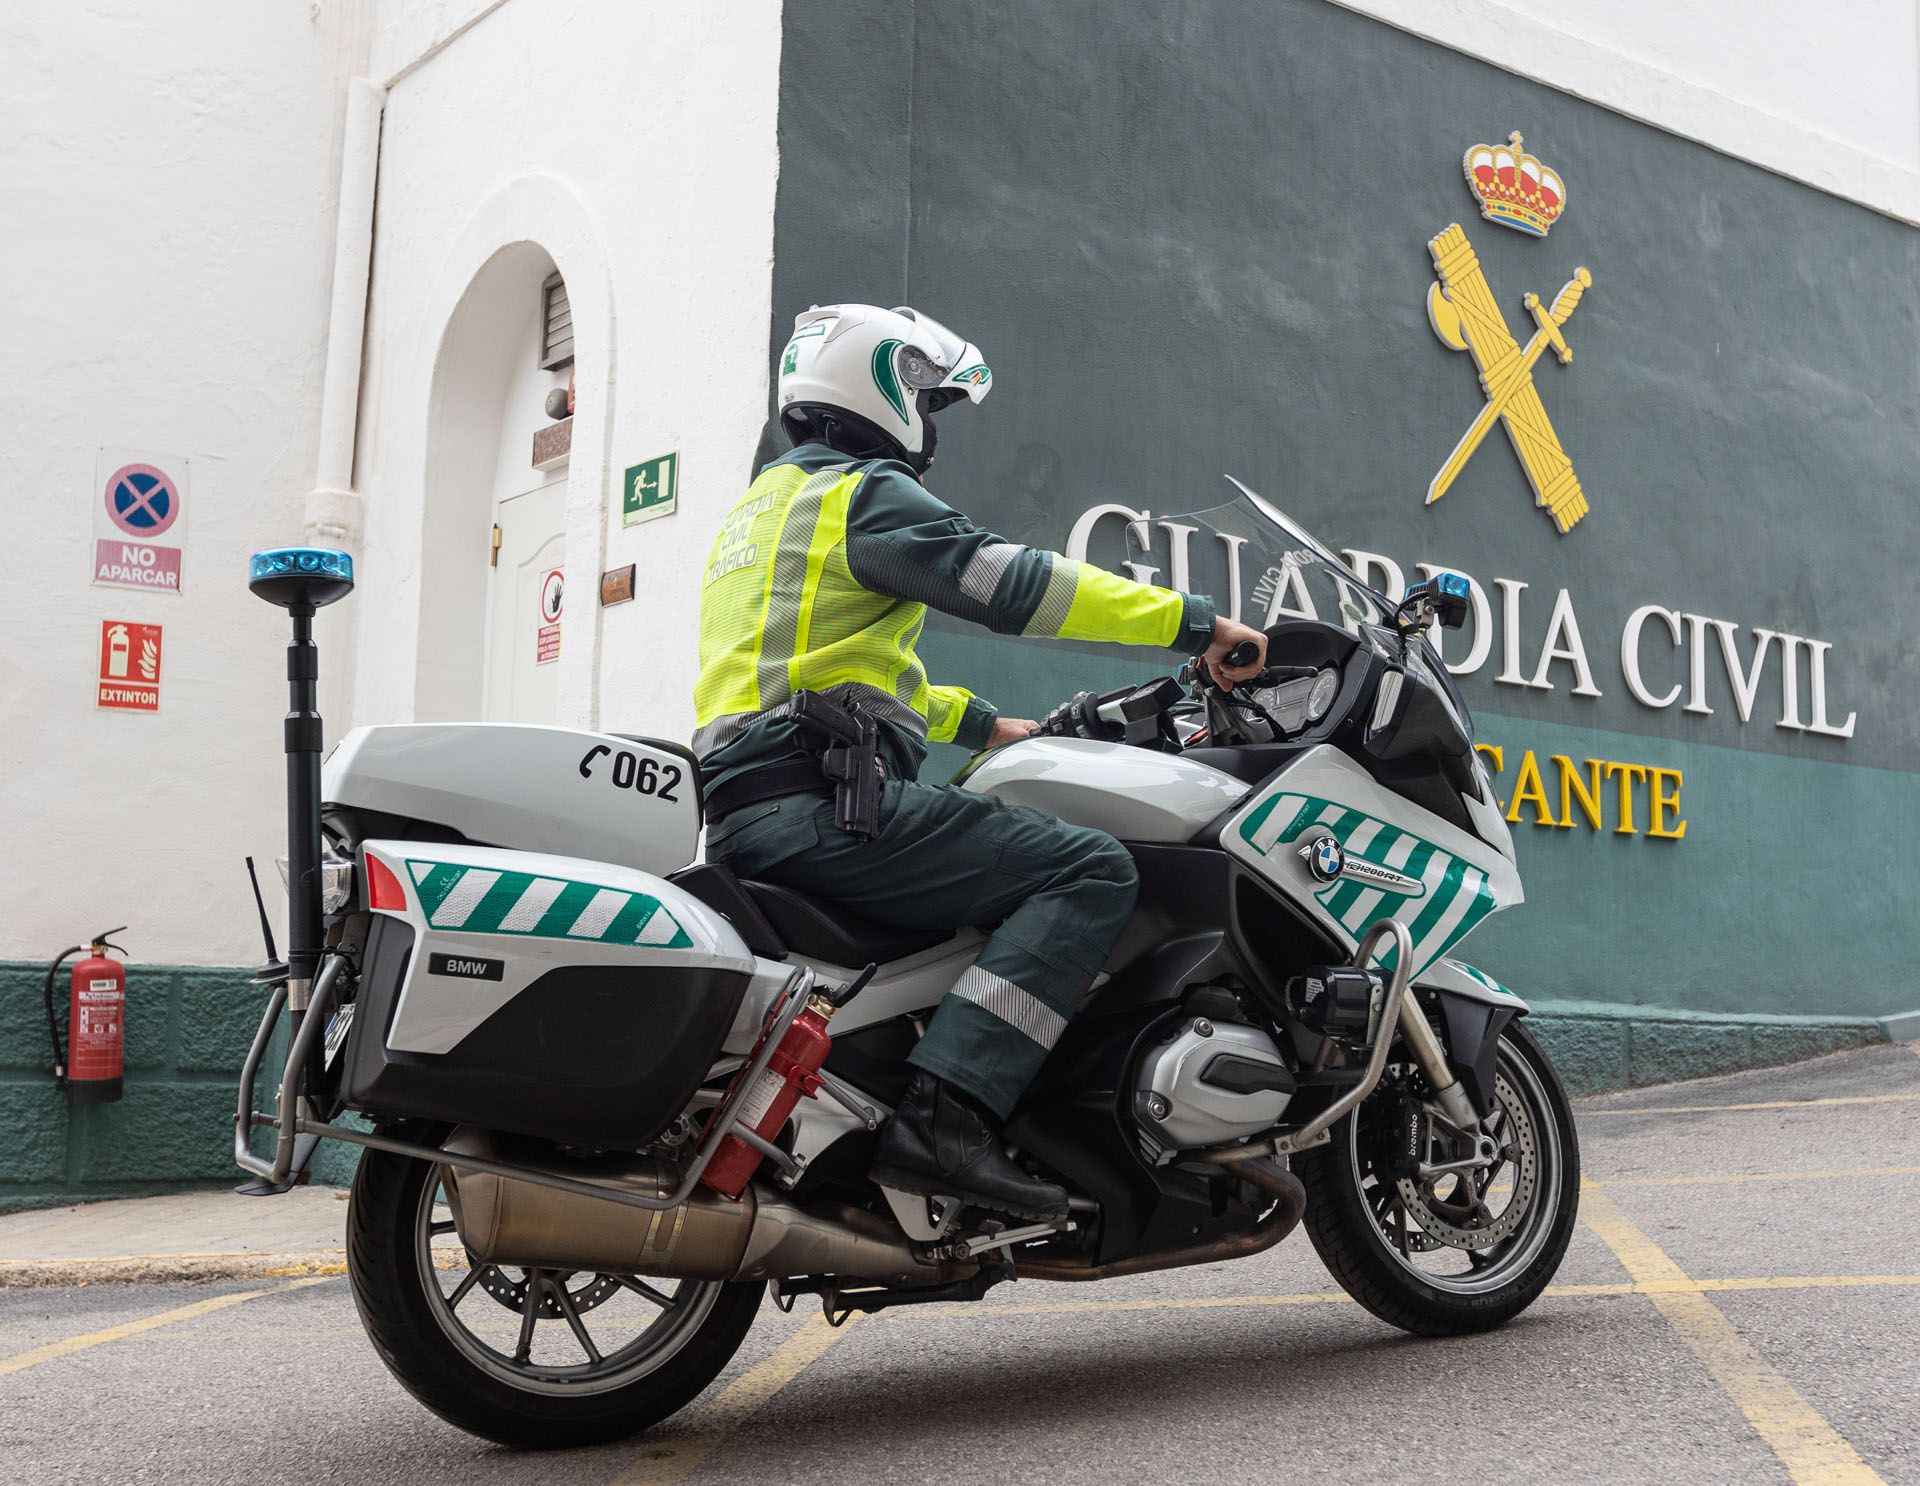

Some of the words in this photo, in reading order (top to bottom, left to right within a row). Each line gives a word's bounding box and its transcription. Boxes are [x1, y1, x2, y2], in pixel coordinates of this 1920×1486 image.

[122, 546, 156, 567] NO
[99, 564, 177, 586] APARCAR
[1620, 604, 1858, 739] CIVIL
[100, 689, 157, 705] EXTINTOR
[611, 750, 683, 803] 062
[445, 959, 487, 976] BMW
[1408, 1114, 1418, 1156] brembo
